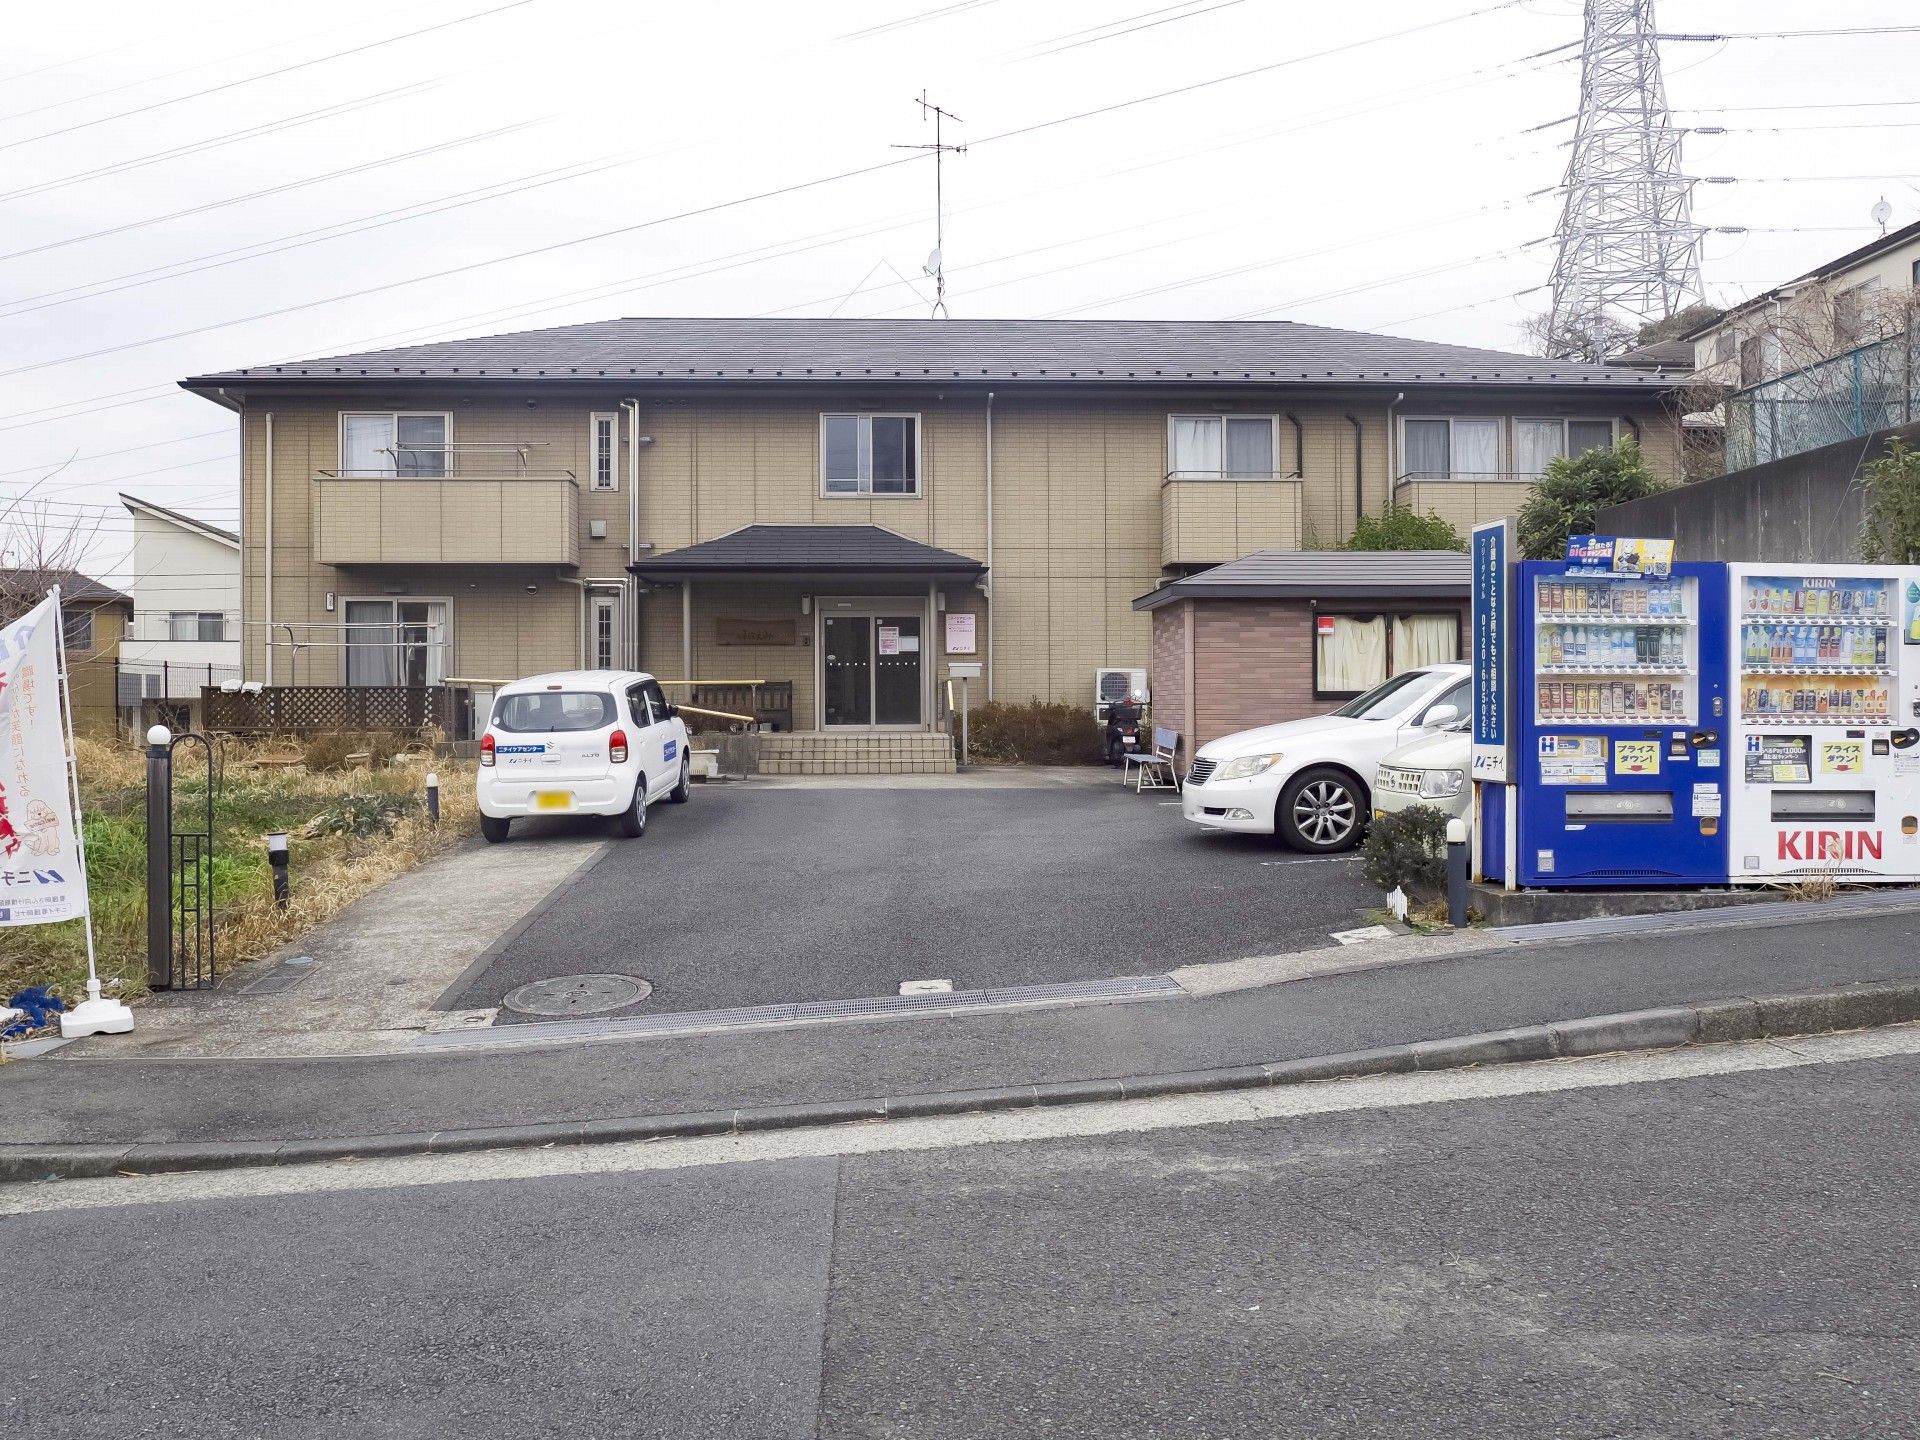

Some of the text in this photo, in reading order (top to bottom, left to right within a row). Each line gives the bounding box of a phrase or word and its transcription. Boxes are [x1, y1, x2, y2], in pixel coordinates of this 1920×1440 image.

[1802, 578, 1836, 589] KIRIN
[498, 745, 543, 753] ニチイケアセンター
[1618, 745, 1656, 753] プライス
[1824, 745, 1861, 753] プライス
[1487, 755, 1505, 772] ニチイ
[1778, 831, 1882, 860] KIRIN
